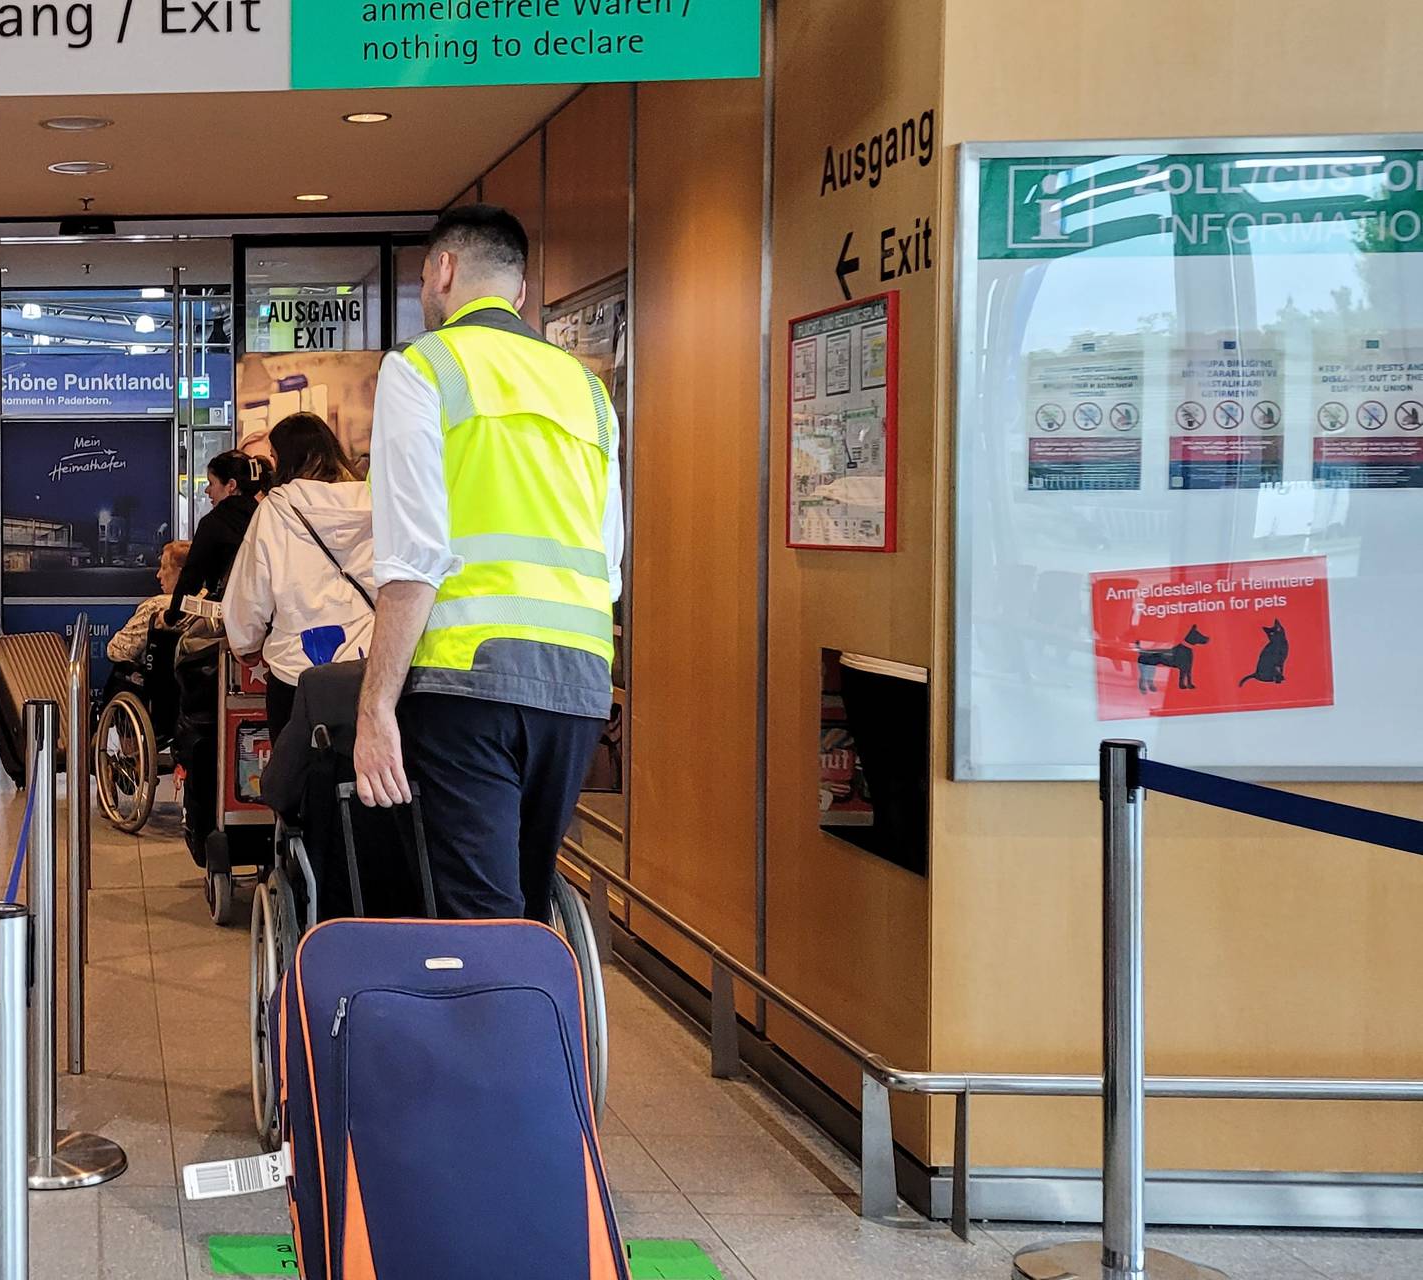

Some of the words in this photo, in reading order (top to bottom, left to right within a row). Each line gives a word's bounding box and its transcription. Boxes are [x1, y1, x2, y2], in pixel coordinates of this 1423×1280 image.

[161, 0, 261, 33] Exit
[362, 0, 560, 21] anmeldefreie
[362, 34, 478, 64] nothing
[492, 35, 522, 57] to
[534, 30, 644, 55] declare
[820, 108, 934, 197] Ausgang
[880, 216, 932, 282] Exit
[268, 300, 360, 323] AUSGANG
[294, 327, 337, 348] EXIT
[1369, 374, 1387, 382] OUT
[1384, 384, 1413, 392] UNION
[74, 437, 101, 450] Mein
[49, 456, 126, 481] Heimathafen
[1106, 581, 1212, 600] Anmeldestelle
[1216, 578, 1236, 593] für
[1241, 575, 1314, 591] Heimtiere
[1135, 598, 1225, 618] Registration
[1230, 598, 1252, 610] for
[1254, 594, 1287, 611] pets
